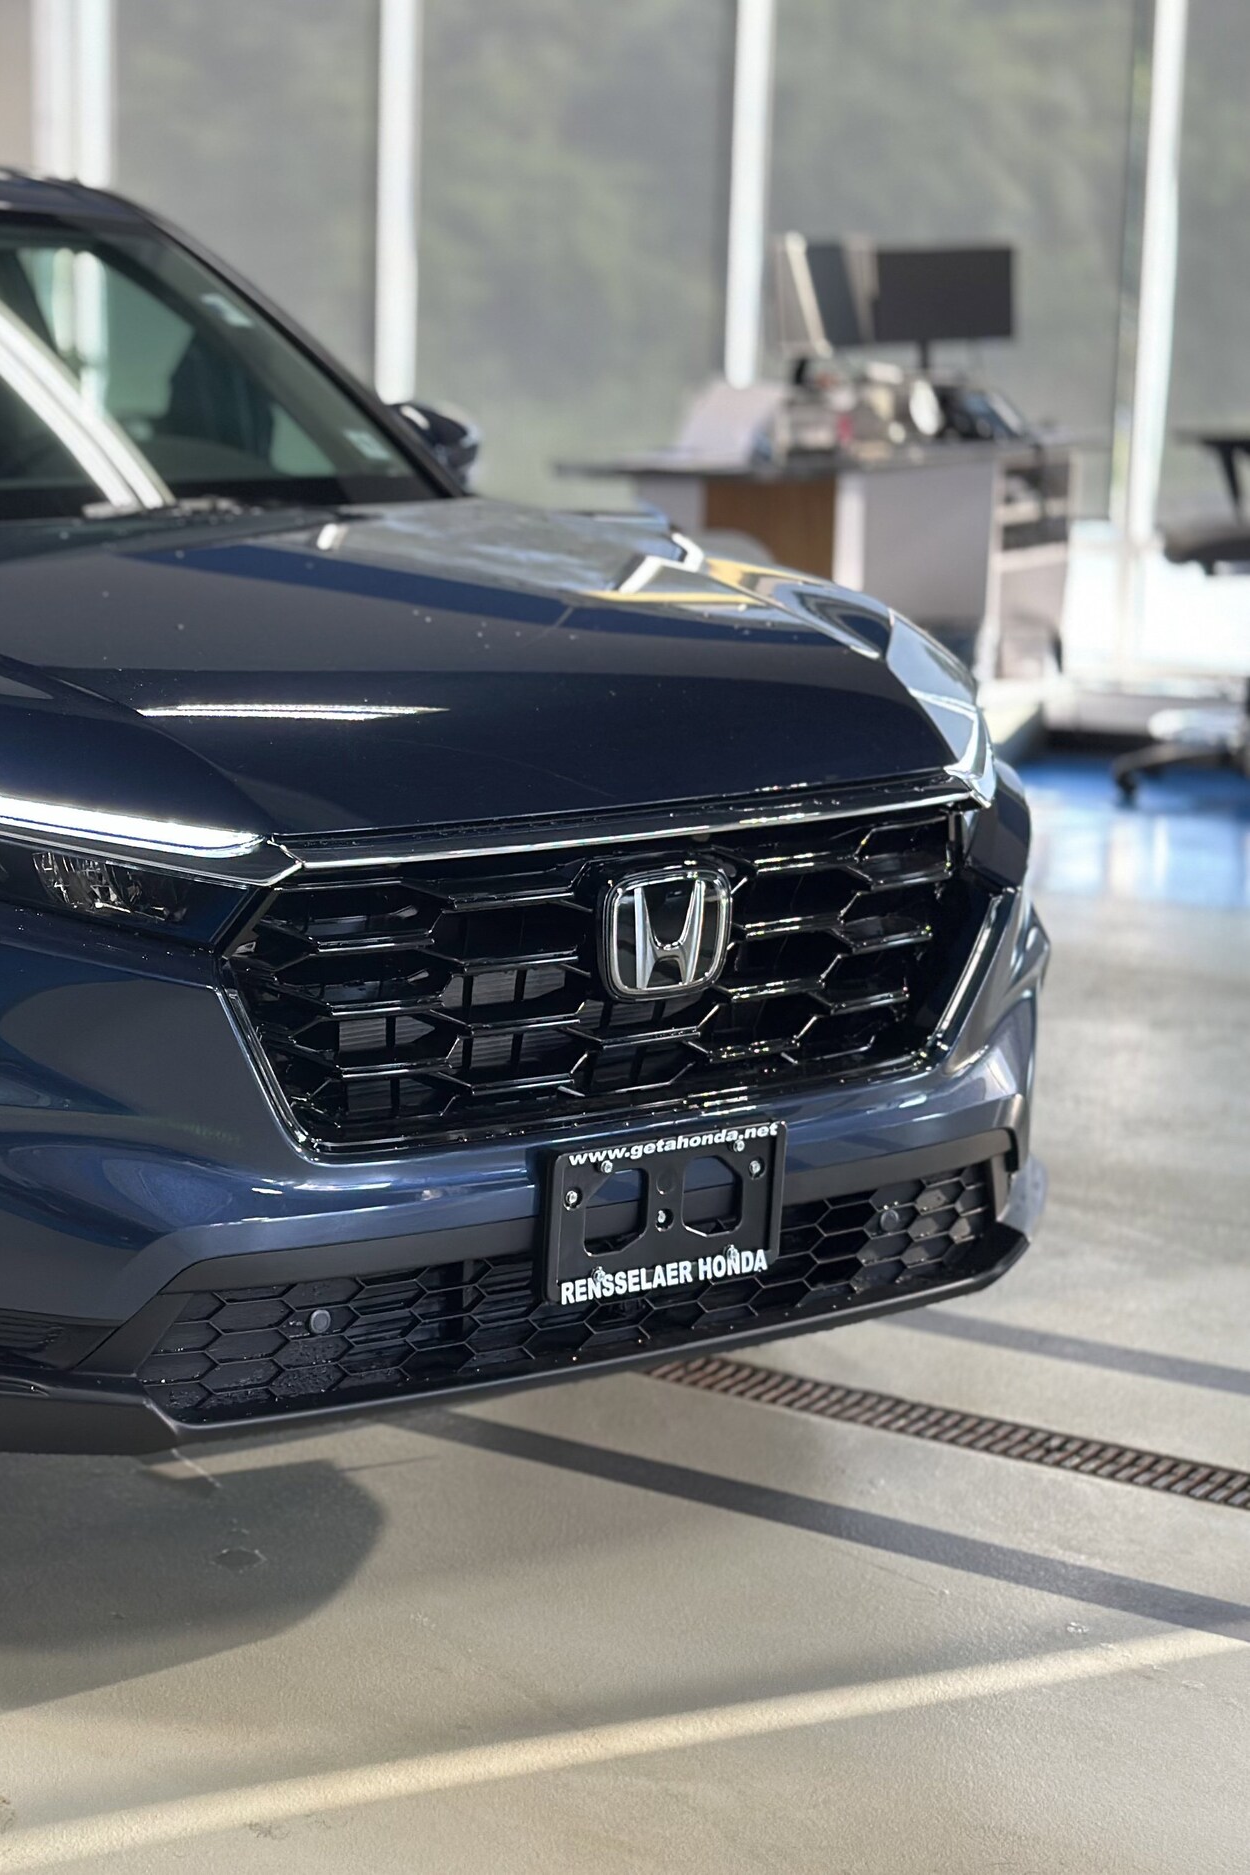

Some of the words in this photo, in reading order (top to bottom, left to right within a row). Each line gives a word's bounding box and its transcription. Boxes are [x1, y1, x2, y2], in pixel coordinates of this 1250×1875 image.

[569, 1123, 778, 1166] www.getahonda.net
[561, 1261, 693, 1305] RENSSELAER
[698, 1249, 768, 1281] HONDA
